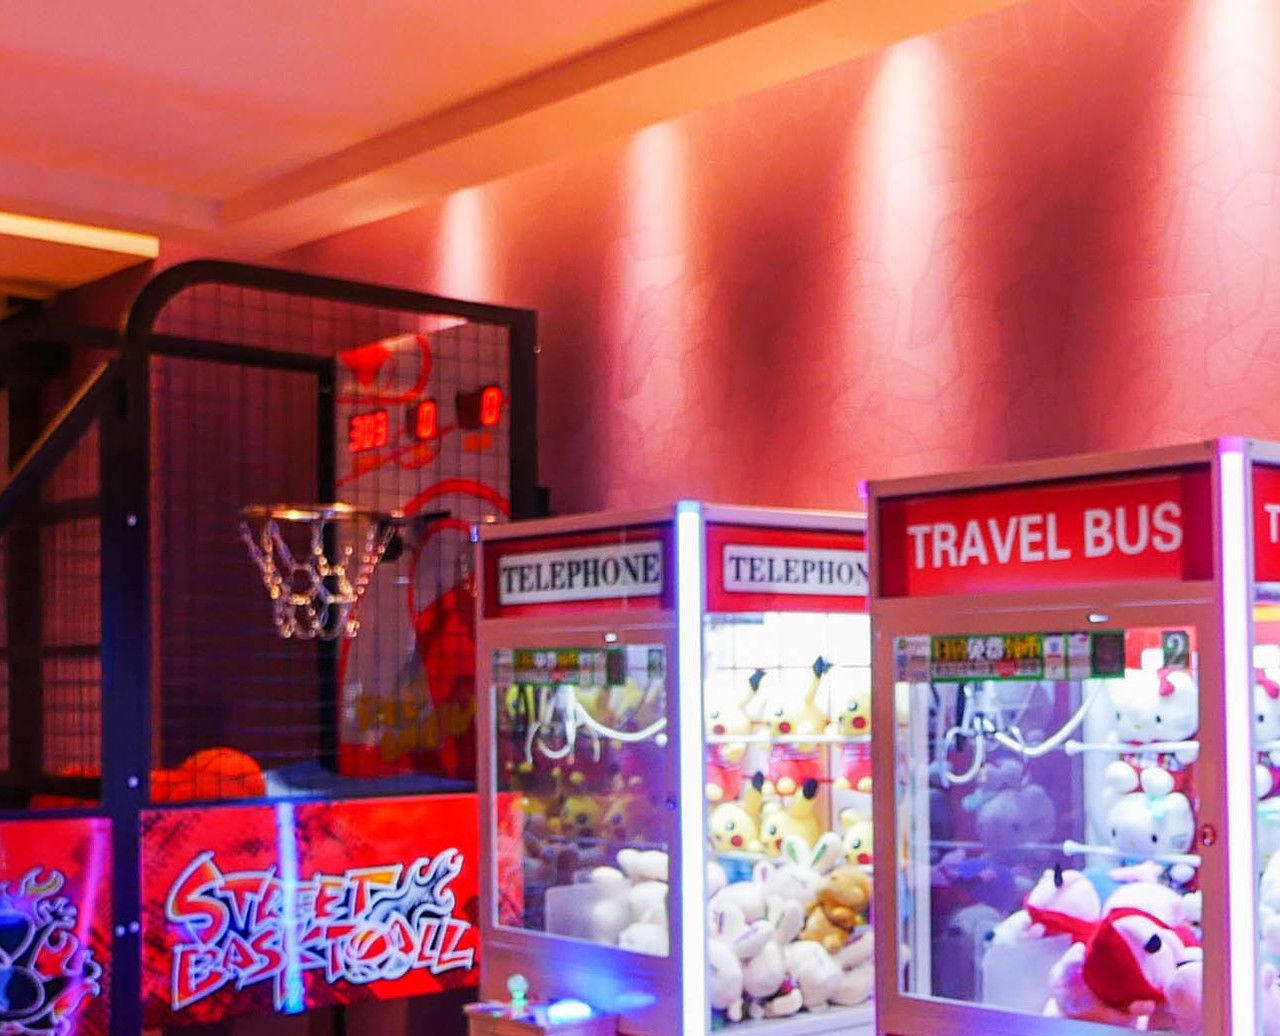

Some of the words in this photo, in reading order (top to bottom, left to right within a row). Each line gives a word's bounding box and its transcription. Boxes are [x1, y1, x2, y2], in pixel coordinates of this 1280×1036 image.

[907, 513, 1071, 570] TRAVEL
[1083, 501, 1184, 560] BUS
[501, 552, 661, 595] TELEPHONE
[729, 555, 869, 587] TELEPHON
[1166, 632, 1186, 668] 2
[167, 852, 403, 946] STREET
